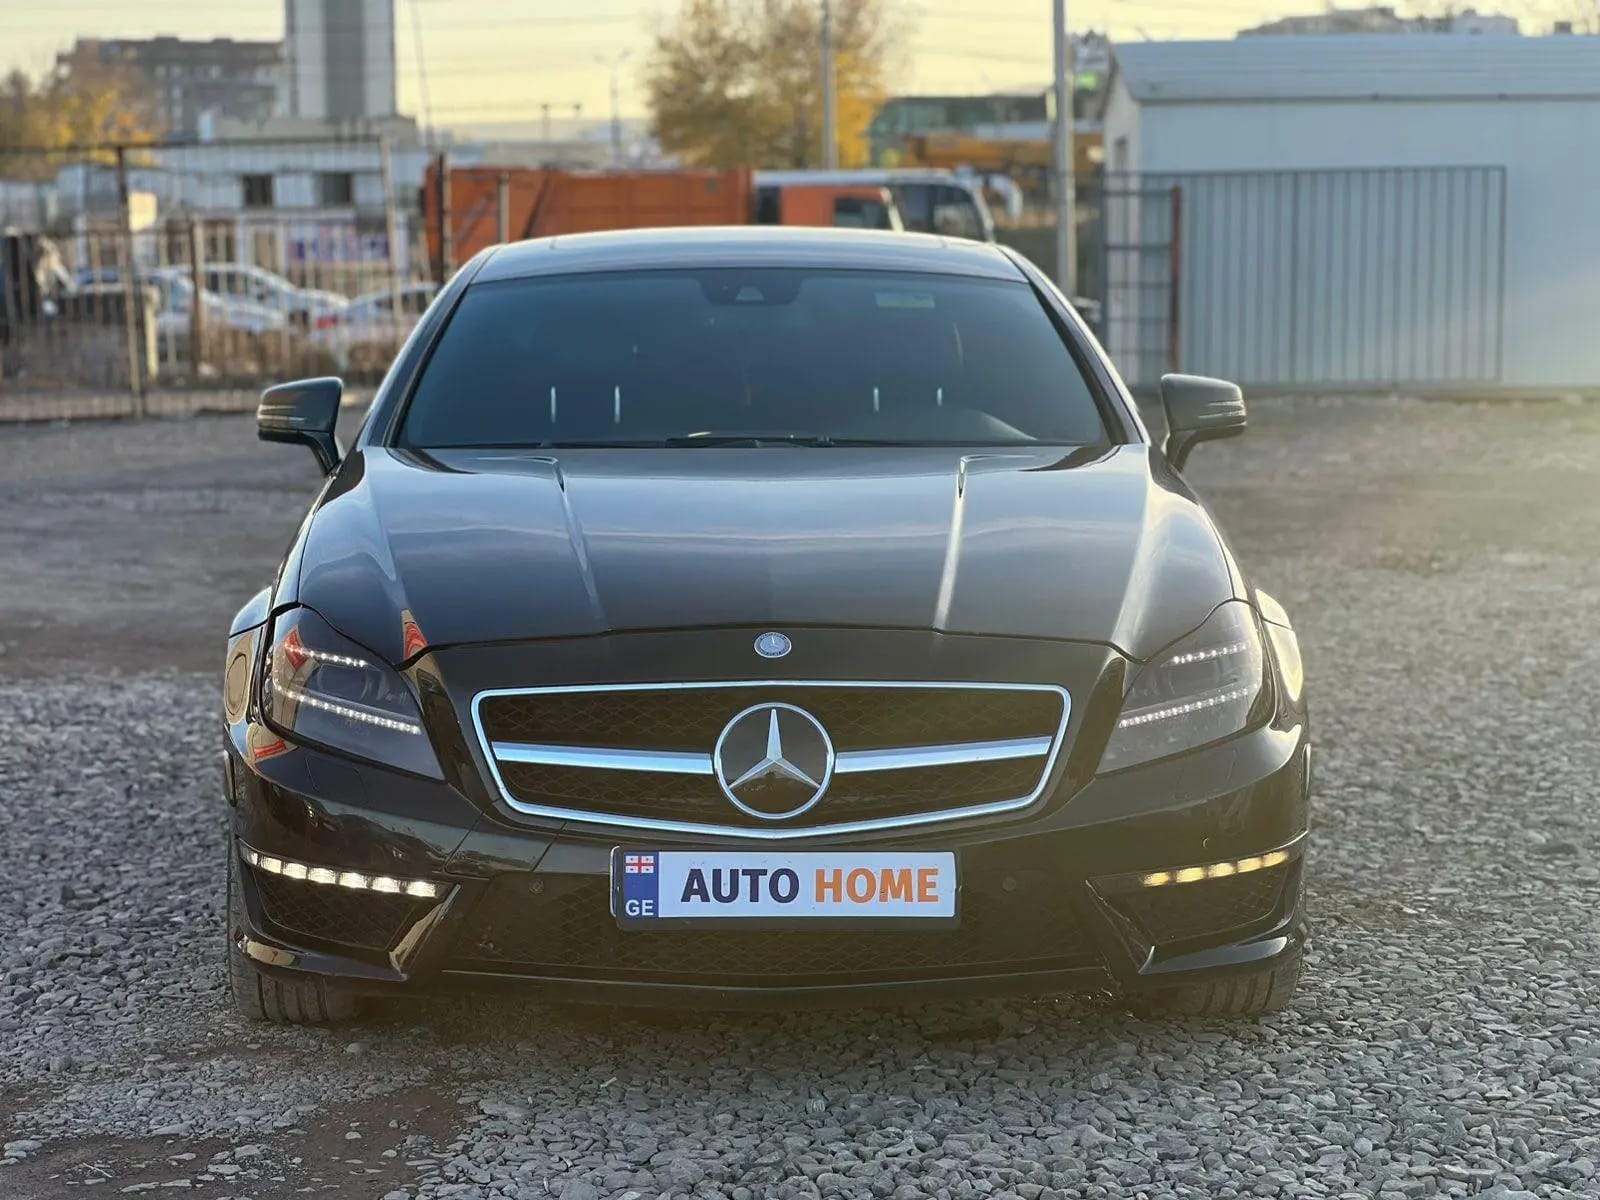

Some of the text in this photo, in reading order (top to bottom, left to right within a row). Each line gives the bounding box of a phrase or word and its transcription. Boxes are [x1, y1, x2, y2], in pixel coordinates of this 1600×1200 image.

[680, 868, 939, 903] AUTO HOME
[625, 900, 654, 916] GE
